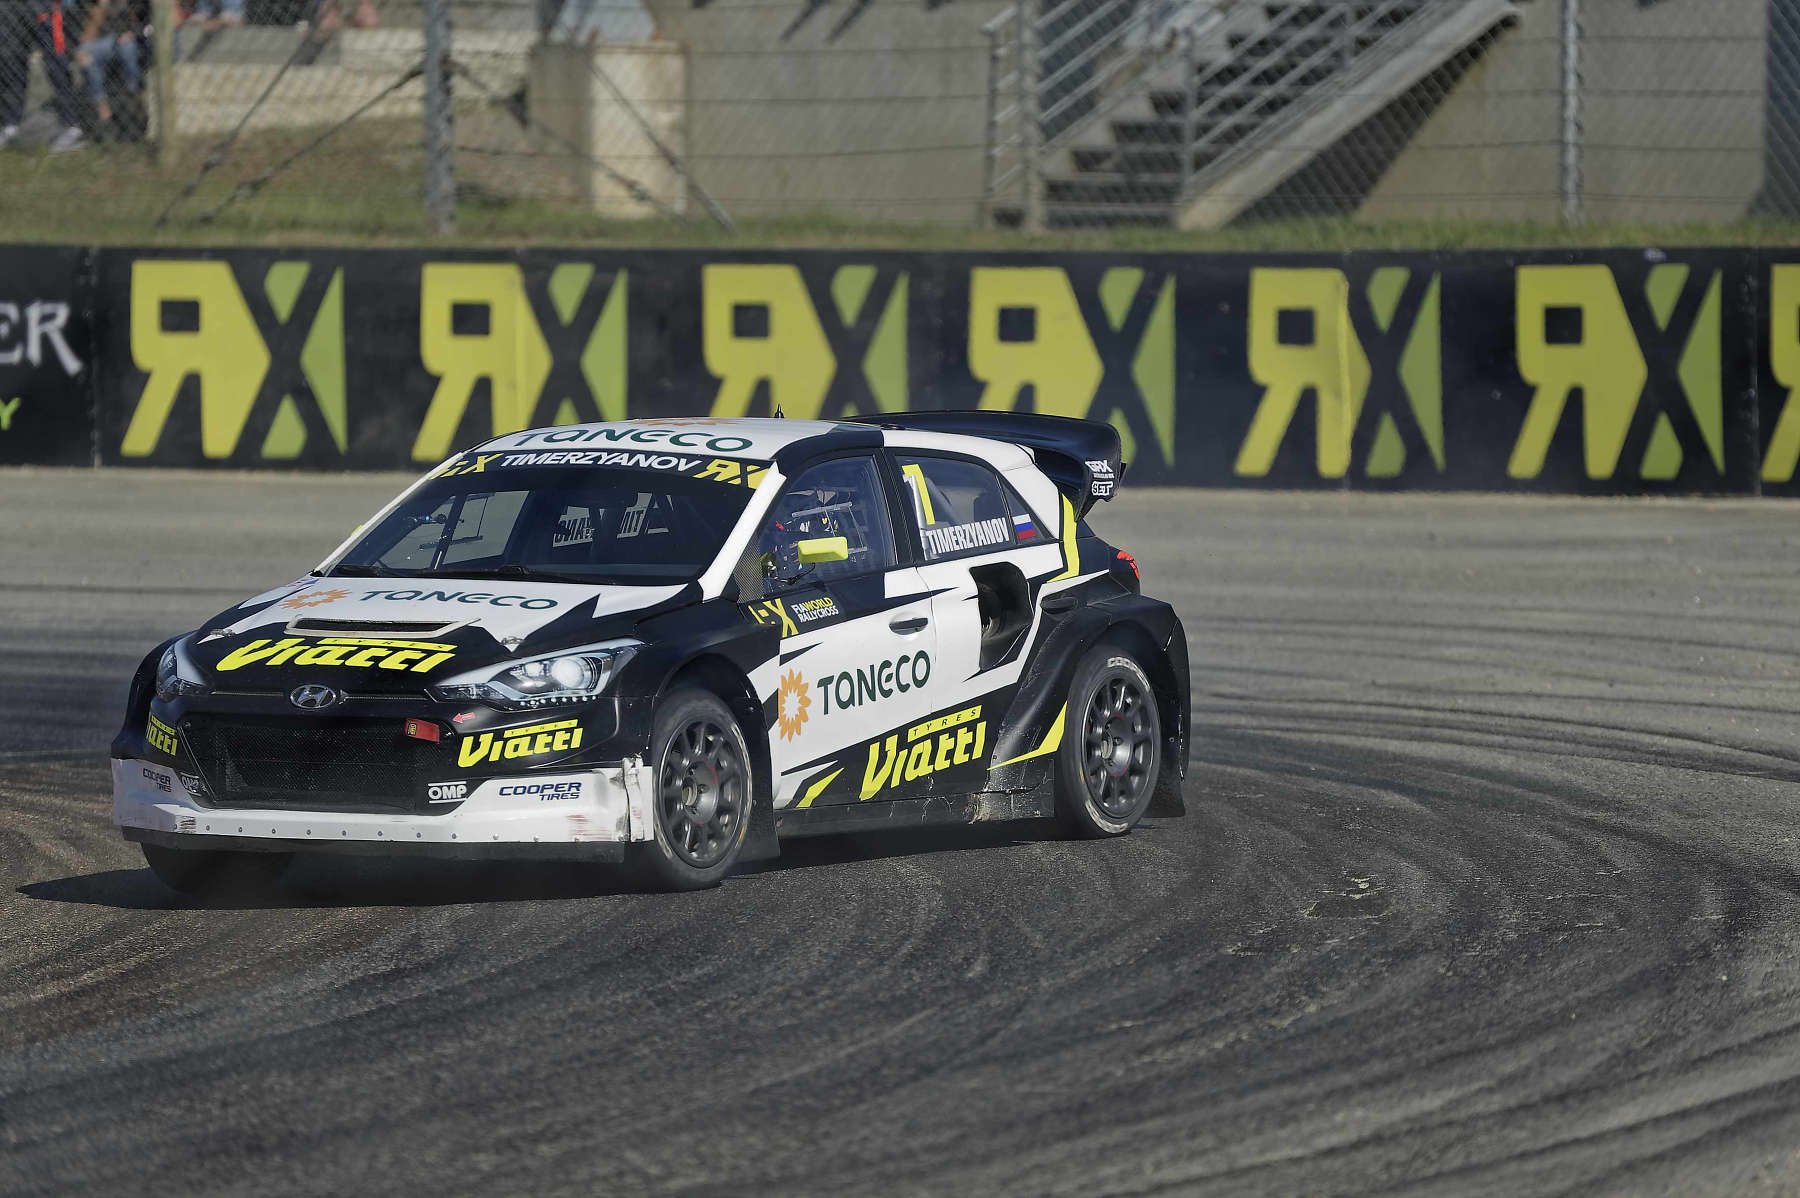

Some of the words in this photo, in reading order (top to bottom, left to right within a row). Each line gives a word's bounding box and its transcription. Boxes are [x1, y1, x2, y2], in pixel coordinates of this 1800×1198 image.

[501, 452, 702, 472] TIMERZYANOV
[924, 517, 1010, 555] TIMERZYANOV
[797, 605, 840, 624] RALLYCROSS
[215, 637, 456, 673] Viatti
[912, 708, 977, 737] TYRES
[457, 727, 584, 768] Viatti
[858, 720, 988, 801] Viatti
[428, 783, 468, 801] OMP
[499, 782, 582, 796] COOPER
[539, 792, 580, 801] TIRES
